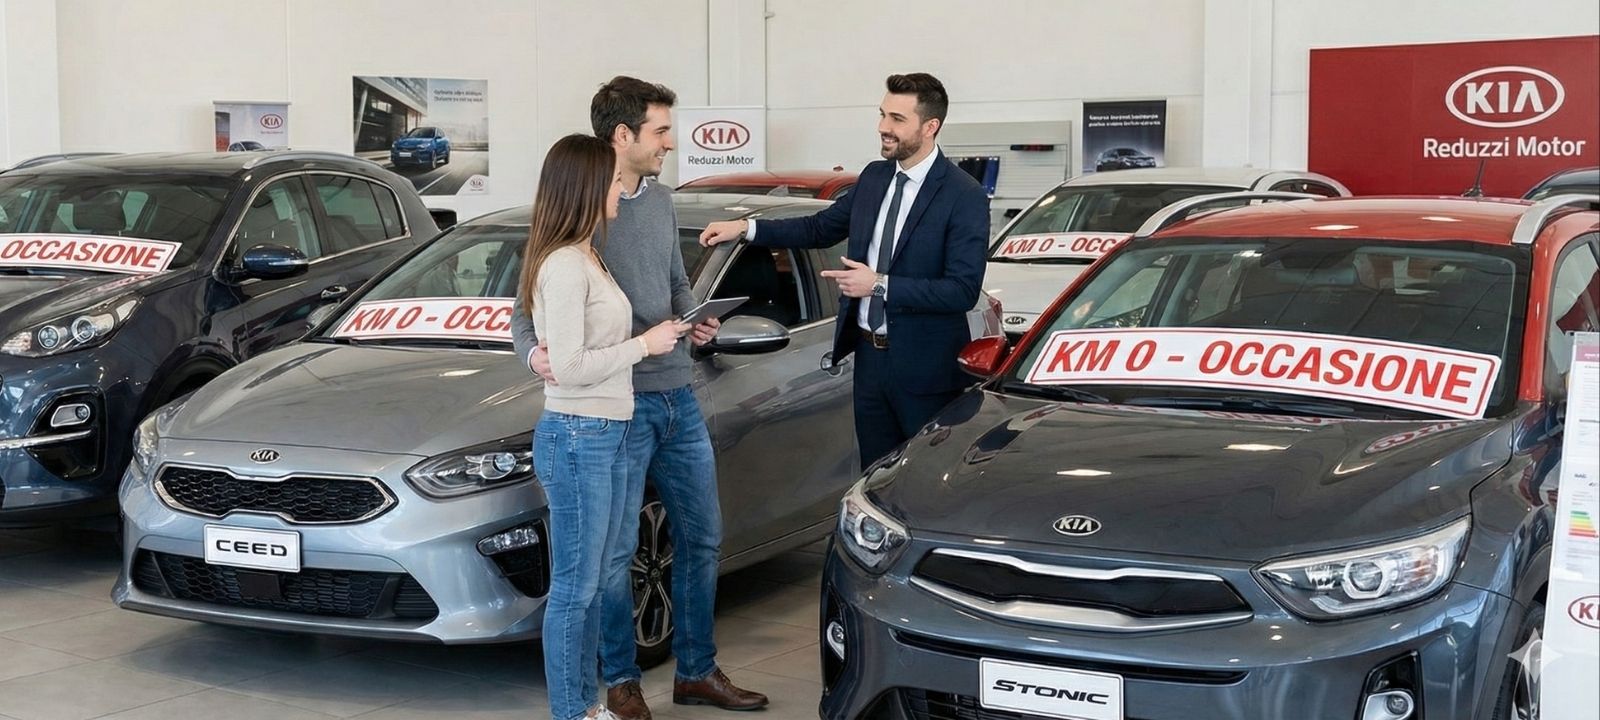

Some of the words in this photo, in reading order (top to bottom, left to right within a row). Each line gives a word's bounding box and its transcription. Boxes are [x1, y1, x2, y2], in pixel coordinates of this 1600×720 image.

[1465, 80, 1544, 114] KIA
[702, 128, 740, 144] KIA
[1423, 137, 1509, 158] Reduzzi
[1517, 136, 1586, 156] Motor
[688, 156, 724, 165] Reduzzi
[727, 156, 754, 165] Motor
[1, 239, 166, 268] OCCASIONE
[1002, 239, 1039, 255] KM
[344, 307, 399, 333] KM
[443, 305, 513, 332] OCC
[1046, 340, 1121, 373] KM
[1199, 340, 1477, 404] OCCASIONE
[253, 450, 275, 460] KIA
[1059, 517, 1092, 531] KIA
[216, 539, 288, 557] CEED
[993, 679, 1109, 705] STONIC
